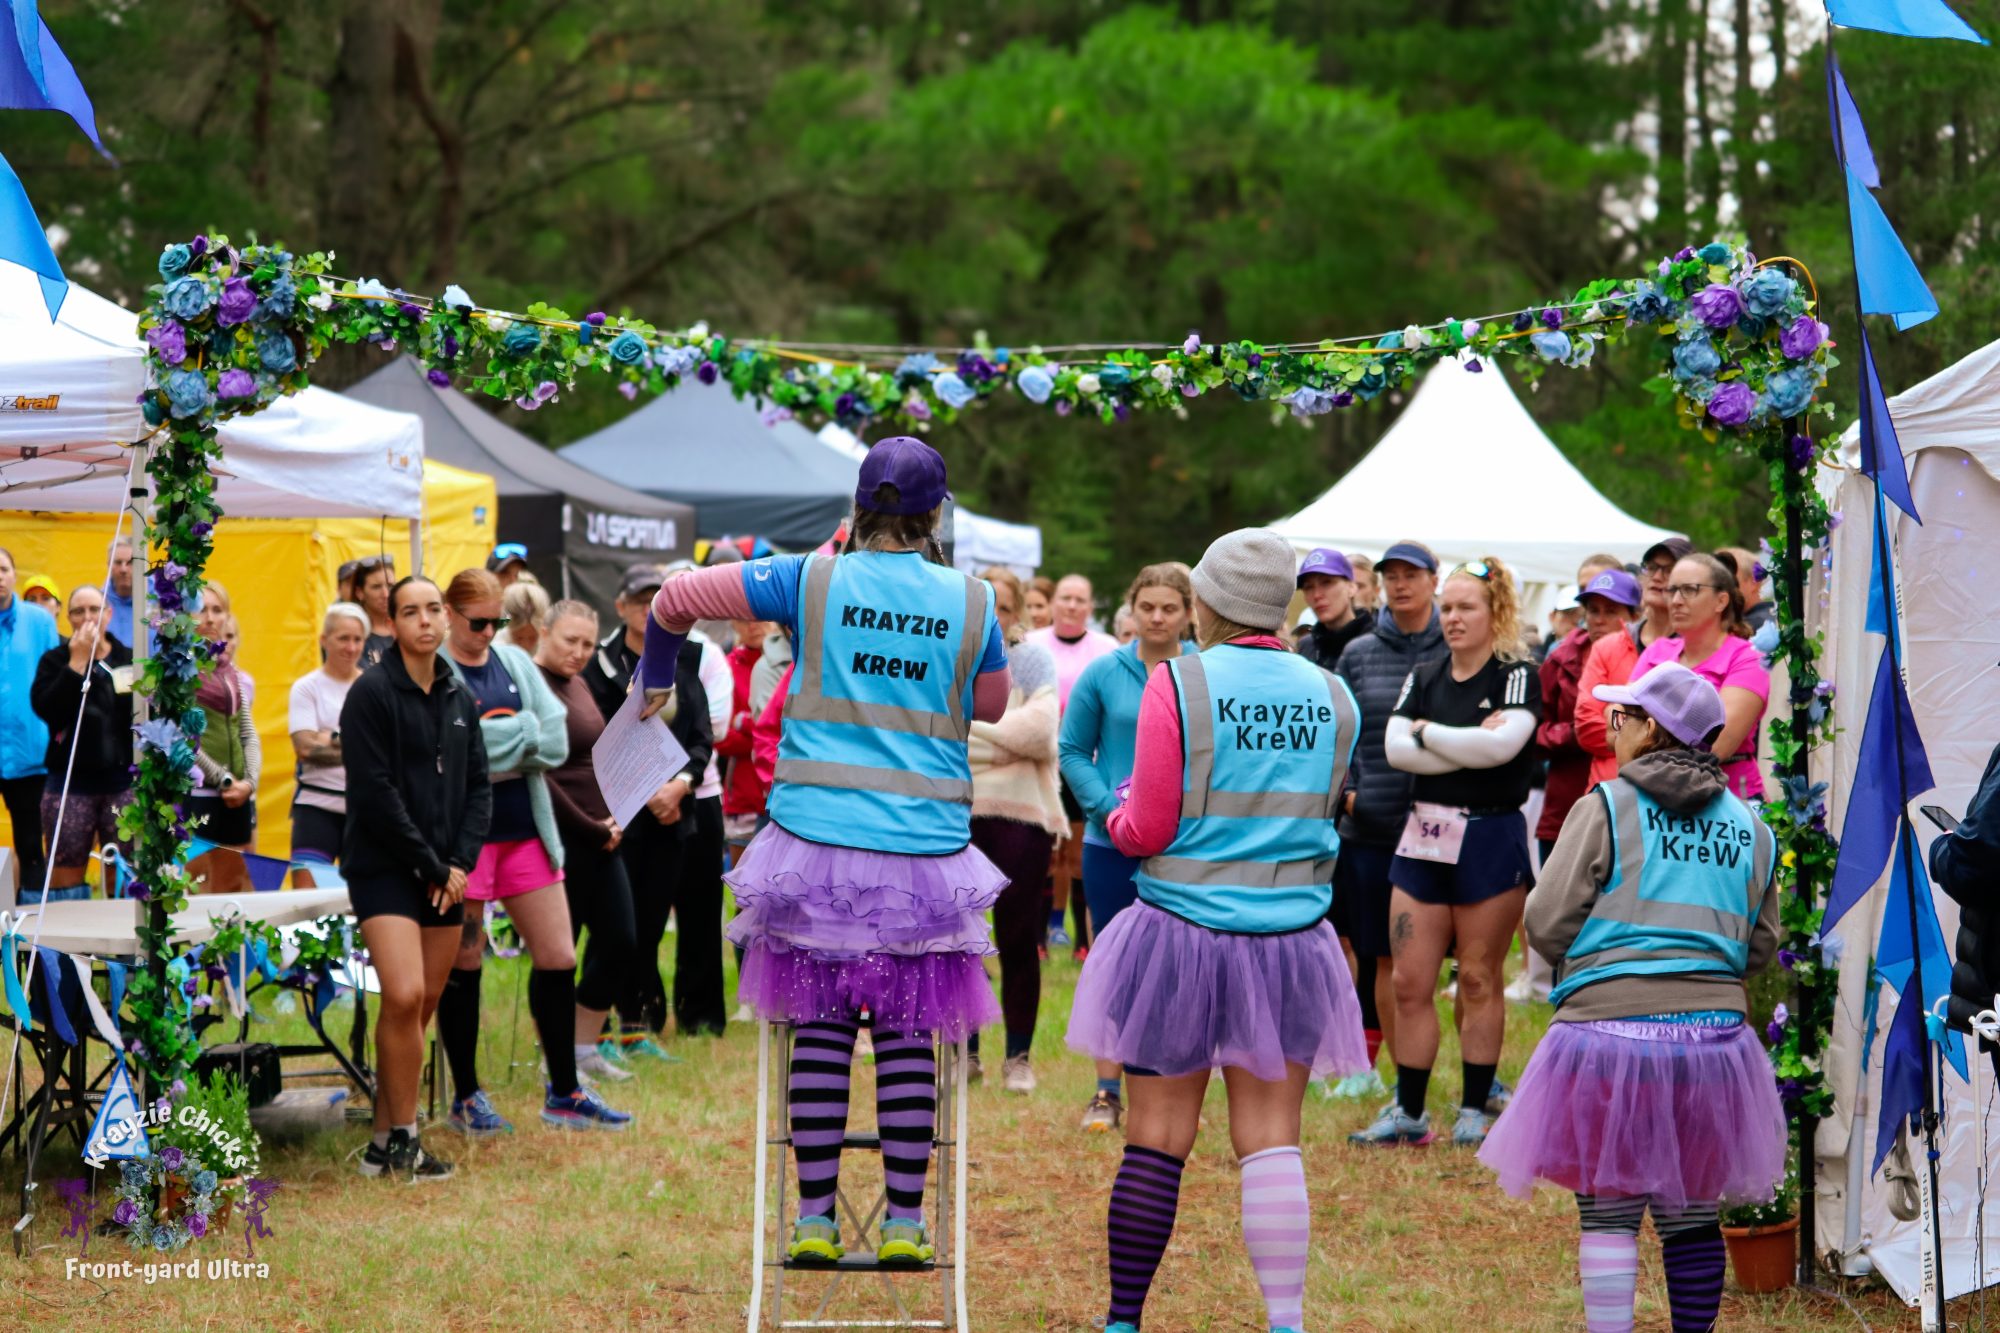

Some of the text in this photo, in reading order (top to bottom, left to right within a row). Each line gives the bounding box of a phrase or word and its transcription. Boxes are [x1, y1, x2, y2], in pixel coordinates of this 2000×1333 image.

[1217, 697, 1331, 728] Krayzie
[1236, 725, 1318, 750] KreW
[1420, 822, 1440, 838] 54
[1646, 808, 1752, 847] Krayzie
[1661, 835, 1741, 869] KreW
[1923, 1250, 1934, 1294] HIRE
